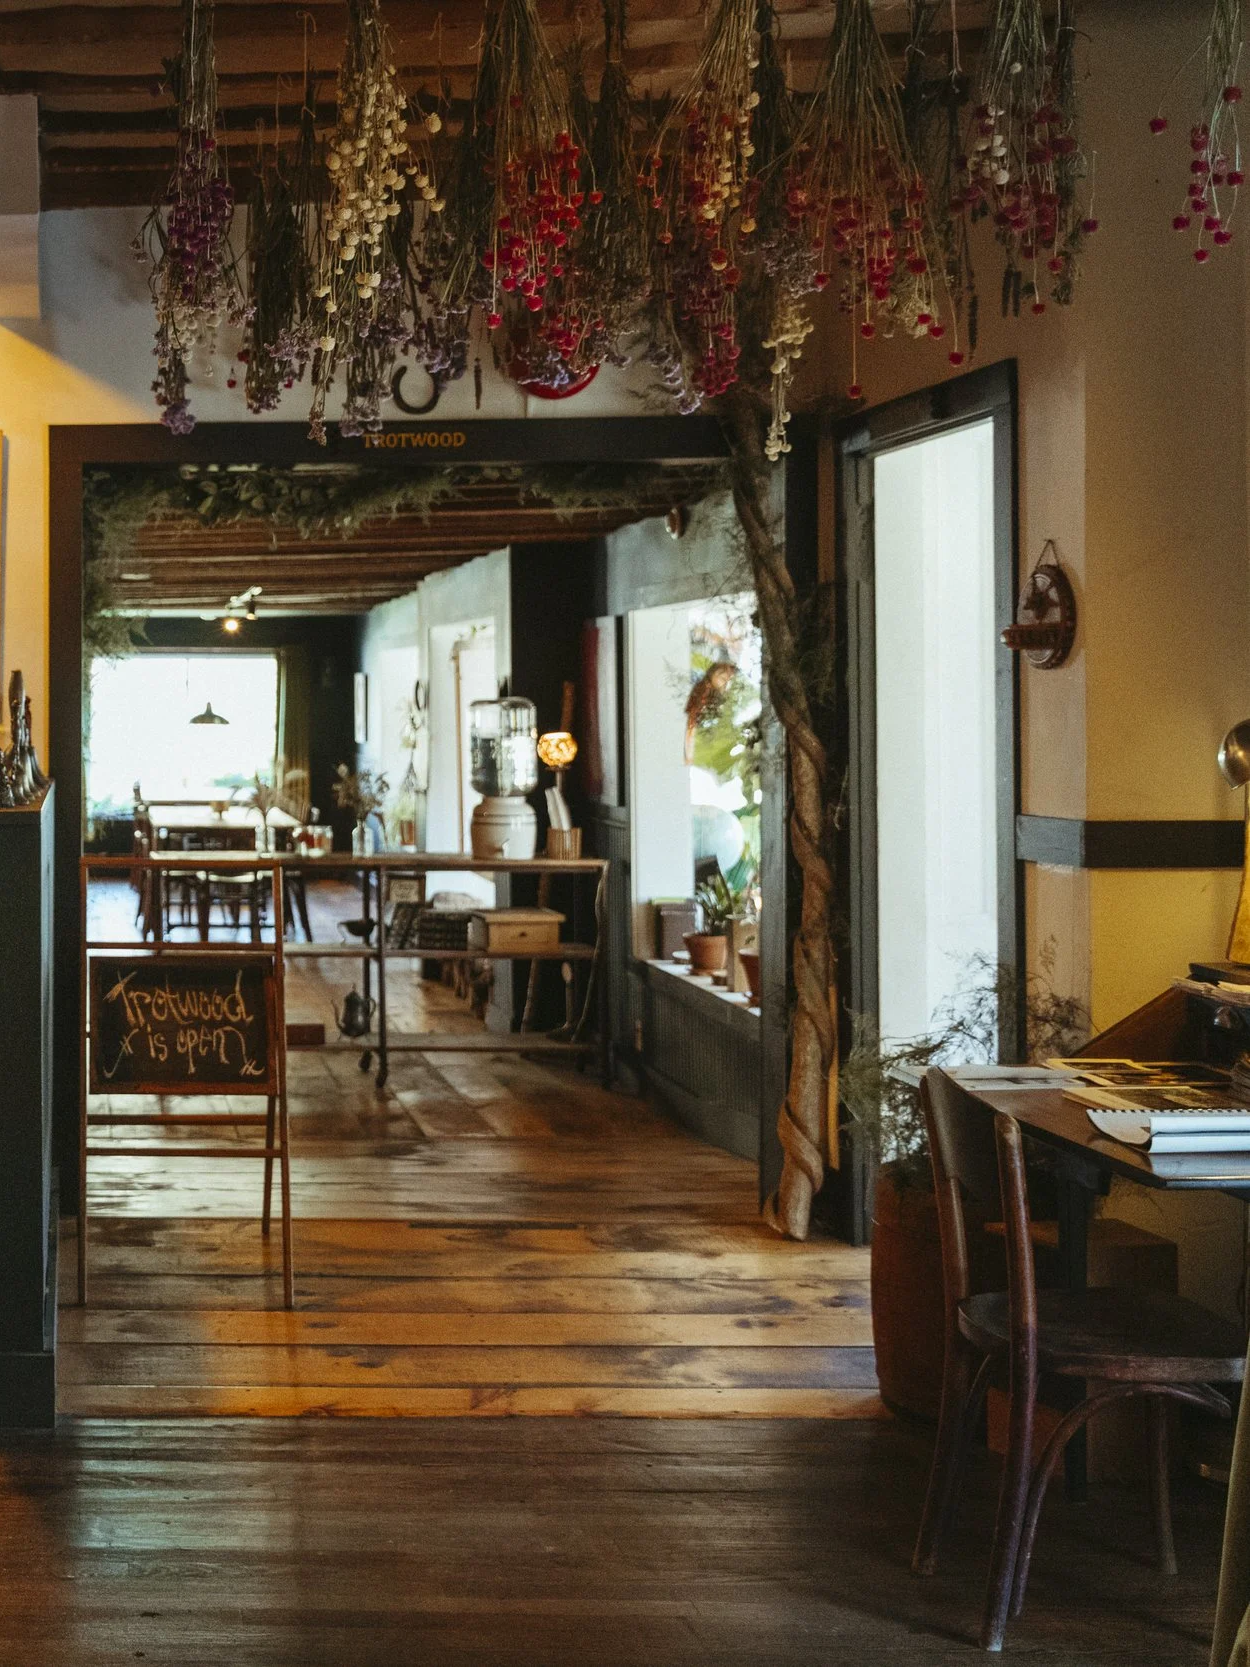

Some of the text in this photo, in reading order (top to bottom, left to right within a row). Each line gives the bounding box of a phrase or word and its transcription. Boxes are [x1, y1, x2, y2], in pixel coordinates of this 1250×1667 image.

[364, 432, 466, 448] TROTWOOD
[103, 969, 253, 1027] Trotwood
[147, 1024, 232, 1075] is open
